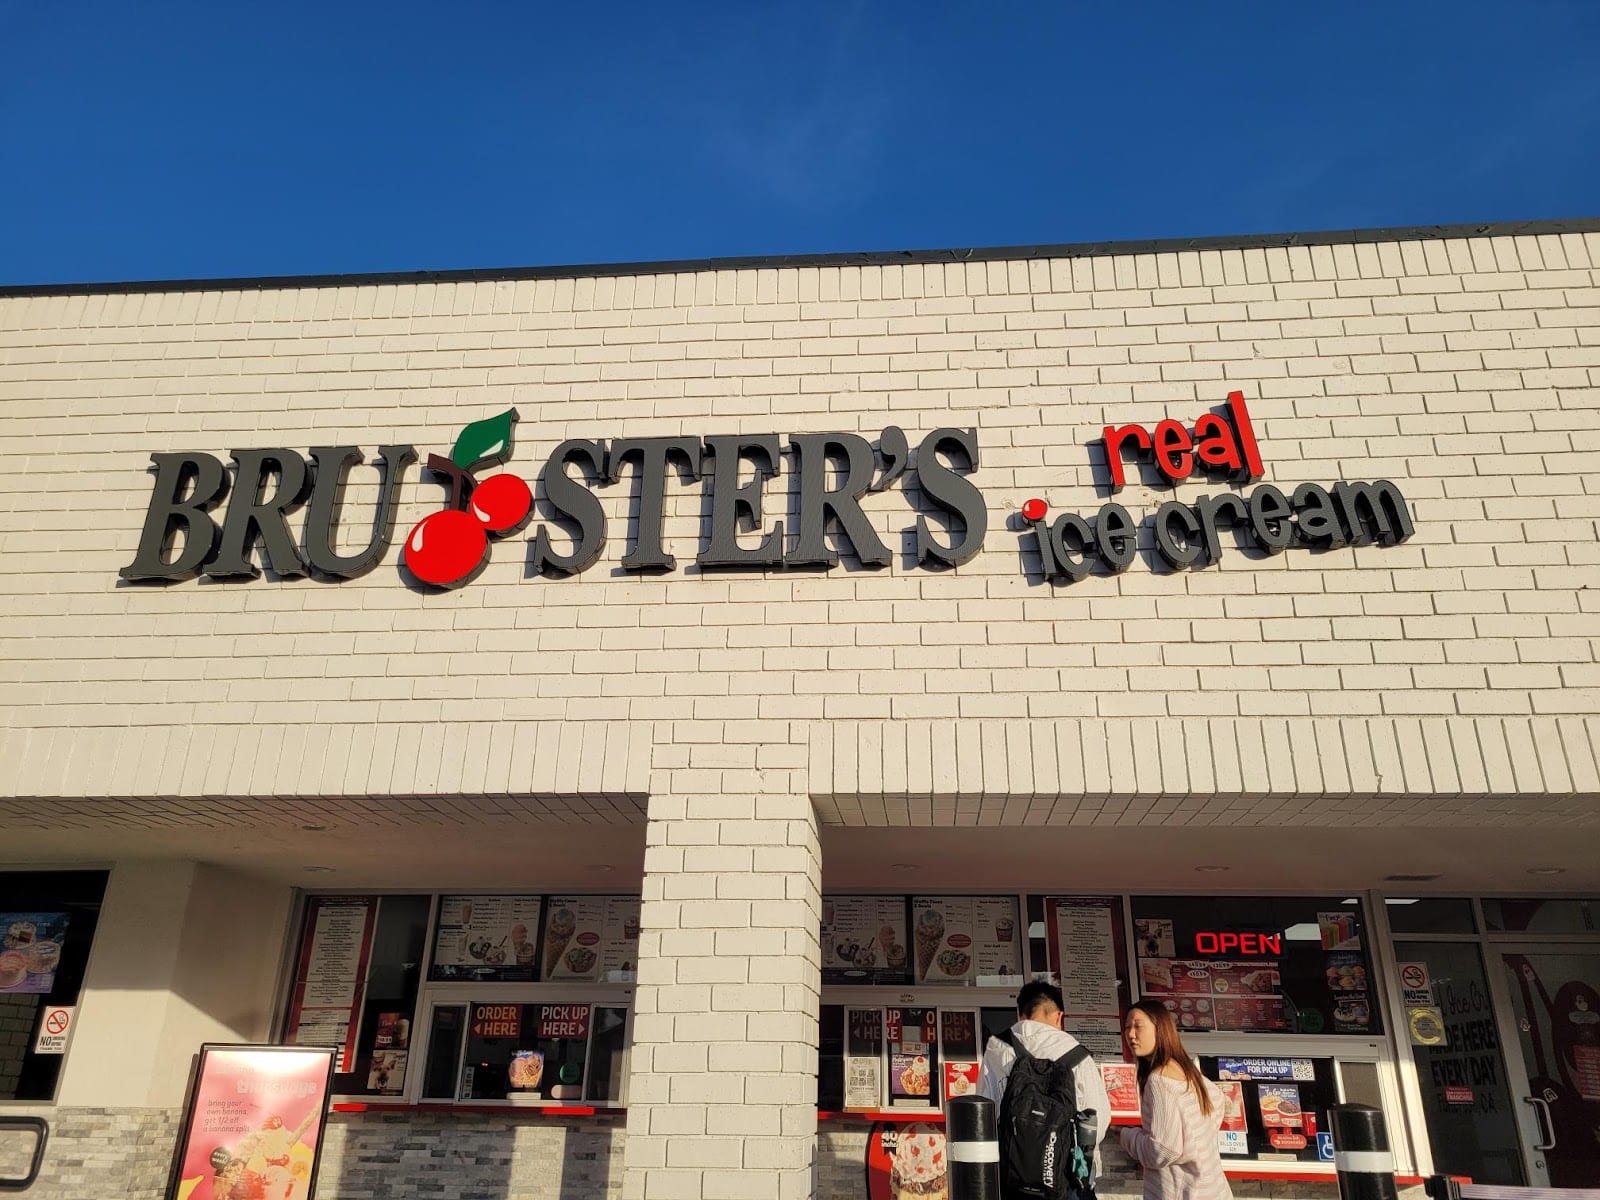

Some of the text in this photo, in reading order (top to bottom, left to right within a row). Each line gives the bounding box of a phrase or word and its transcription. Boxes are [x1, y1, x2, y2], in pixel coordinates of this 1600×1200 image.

[1102, 390, 1267, 494] real
[1021, 479, 1416, 583] ice cream
[1196, 932, 1281, 955] OPEN
[476, 1006, 518, 1020] ORDER
[541, 1006, 589, 1020] PICK UP
[852, 1011, 881, 1024] PICK
[926, 1010, 969, 1026] ODER
[483, 1022, 518, 1036] HERE
[542, 1021, 577, 1036] HERE
[927, 1026, 963, 1041] HRE
[1243, 1058, 1267, 1067] ORDER
[1267, 1058, 1292, 1067] ONLINE
[1247, 1066, 1289, 1074] FOR PICK UP
[208, 1100, 226, 1108] bring
[1226, 1132, 1238, 1141] NO
